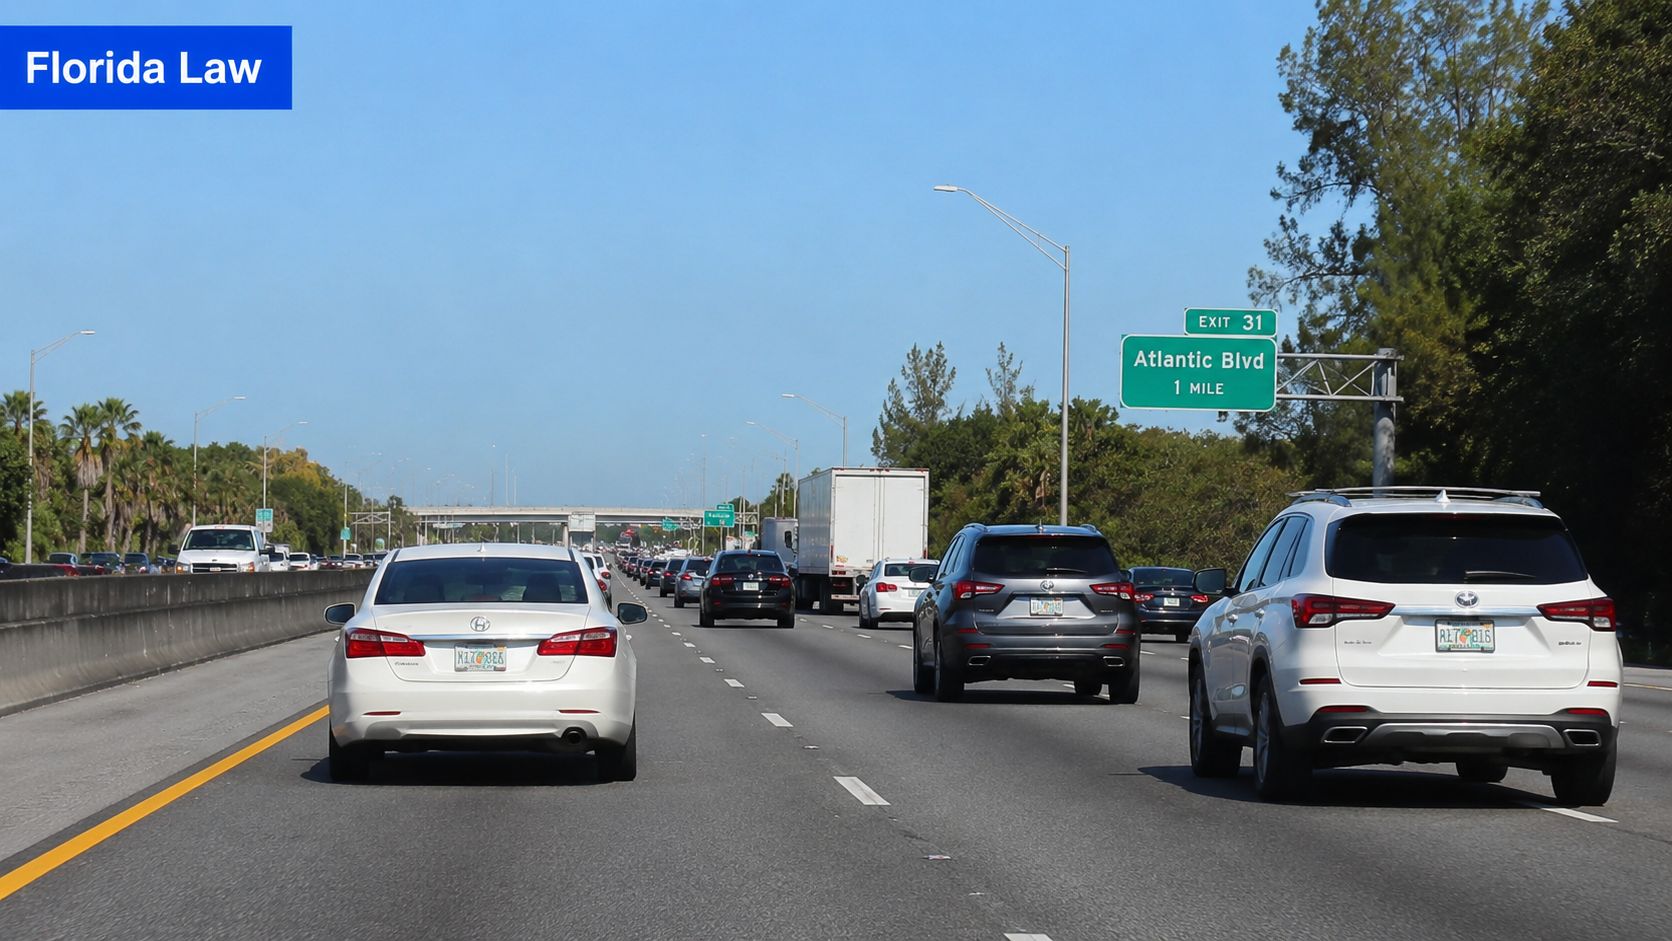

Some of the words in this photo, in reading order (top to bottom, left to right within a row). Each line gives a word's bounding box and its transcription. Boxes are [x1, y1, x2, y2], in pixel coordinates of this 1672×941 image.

[1199, 315, 1230, 328] EXIT
[1242, 314, 1262, 331] 31
[1133, 350, 1213, 369] Atlantic
[1221, 351, 1264, 370] Blvd
[1173, 379, 1180, 395] 1
[1189, 382, 1224, 395] MILE
